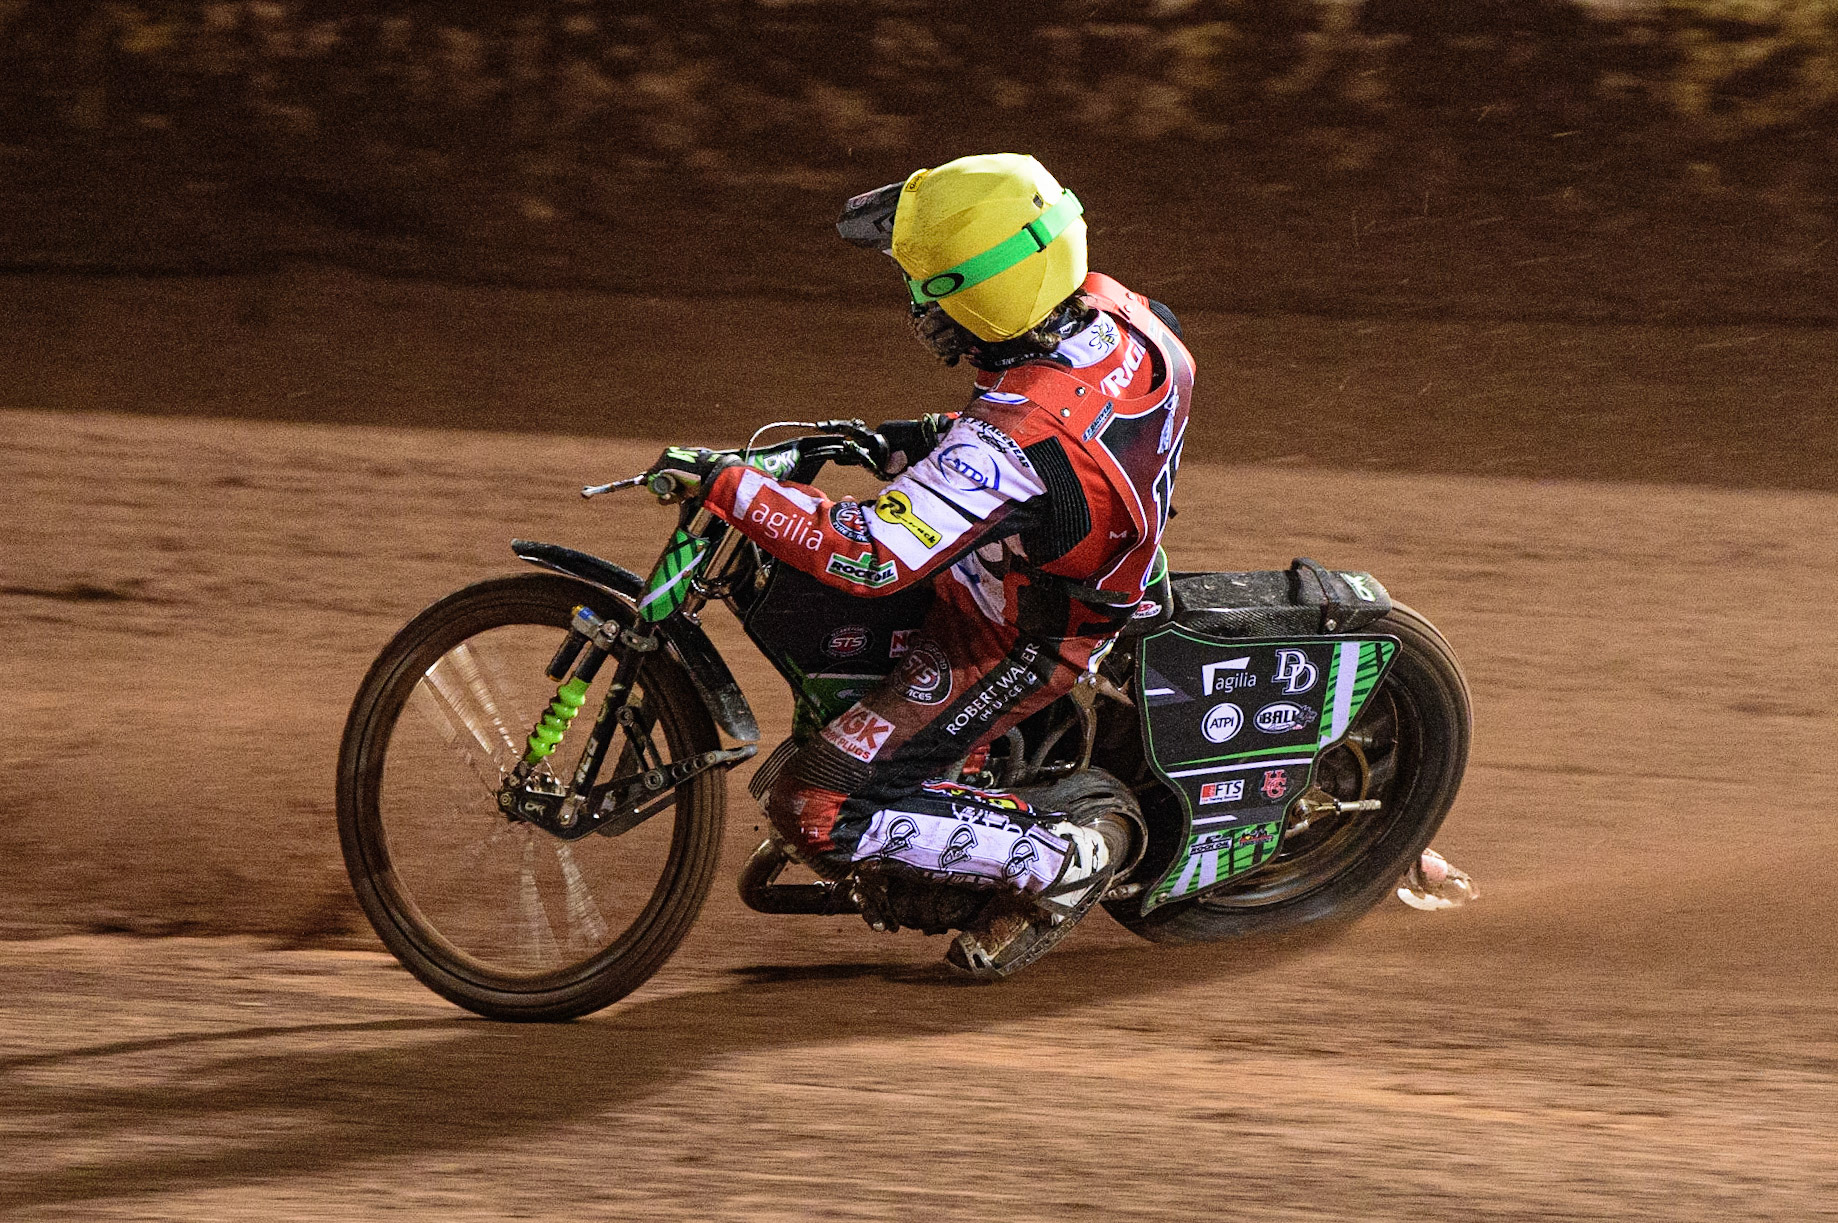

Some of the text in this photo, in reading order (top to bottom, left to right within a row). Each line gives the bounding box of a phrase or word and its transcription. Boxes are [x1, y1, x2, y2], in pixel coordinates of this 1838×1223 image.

[751, 502, 824, 552] agilia
[830, 636, 864, 648] STS
[946, 685, 998, 735] ROBERT
[996, 643, 1040, 688] WALER
[1215, 672, 1257, 693] agilia
[1209, 716, 1234, 729] ATPI
[837, 738, 871, 760] PLUGS
[1215, 780, 1242, 796] FTS
